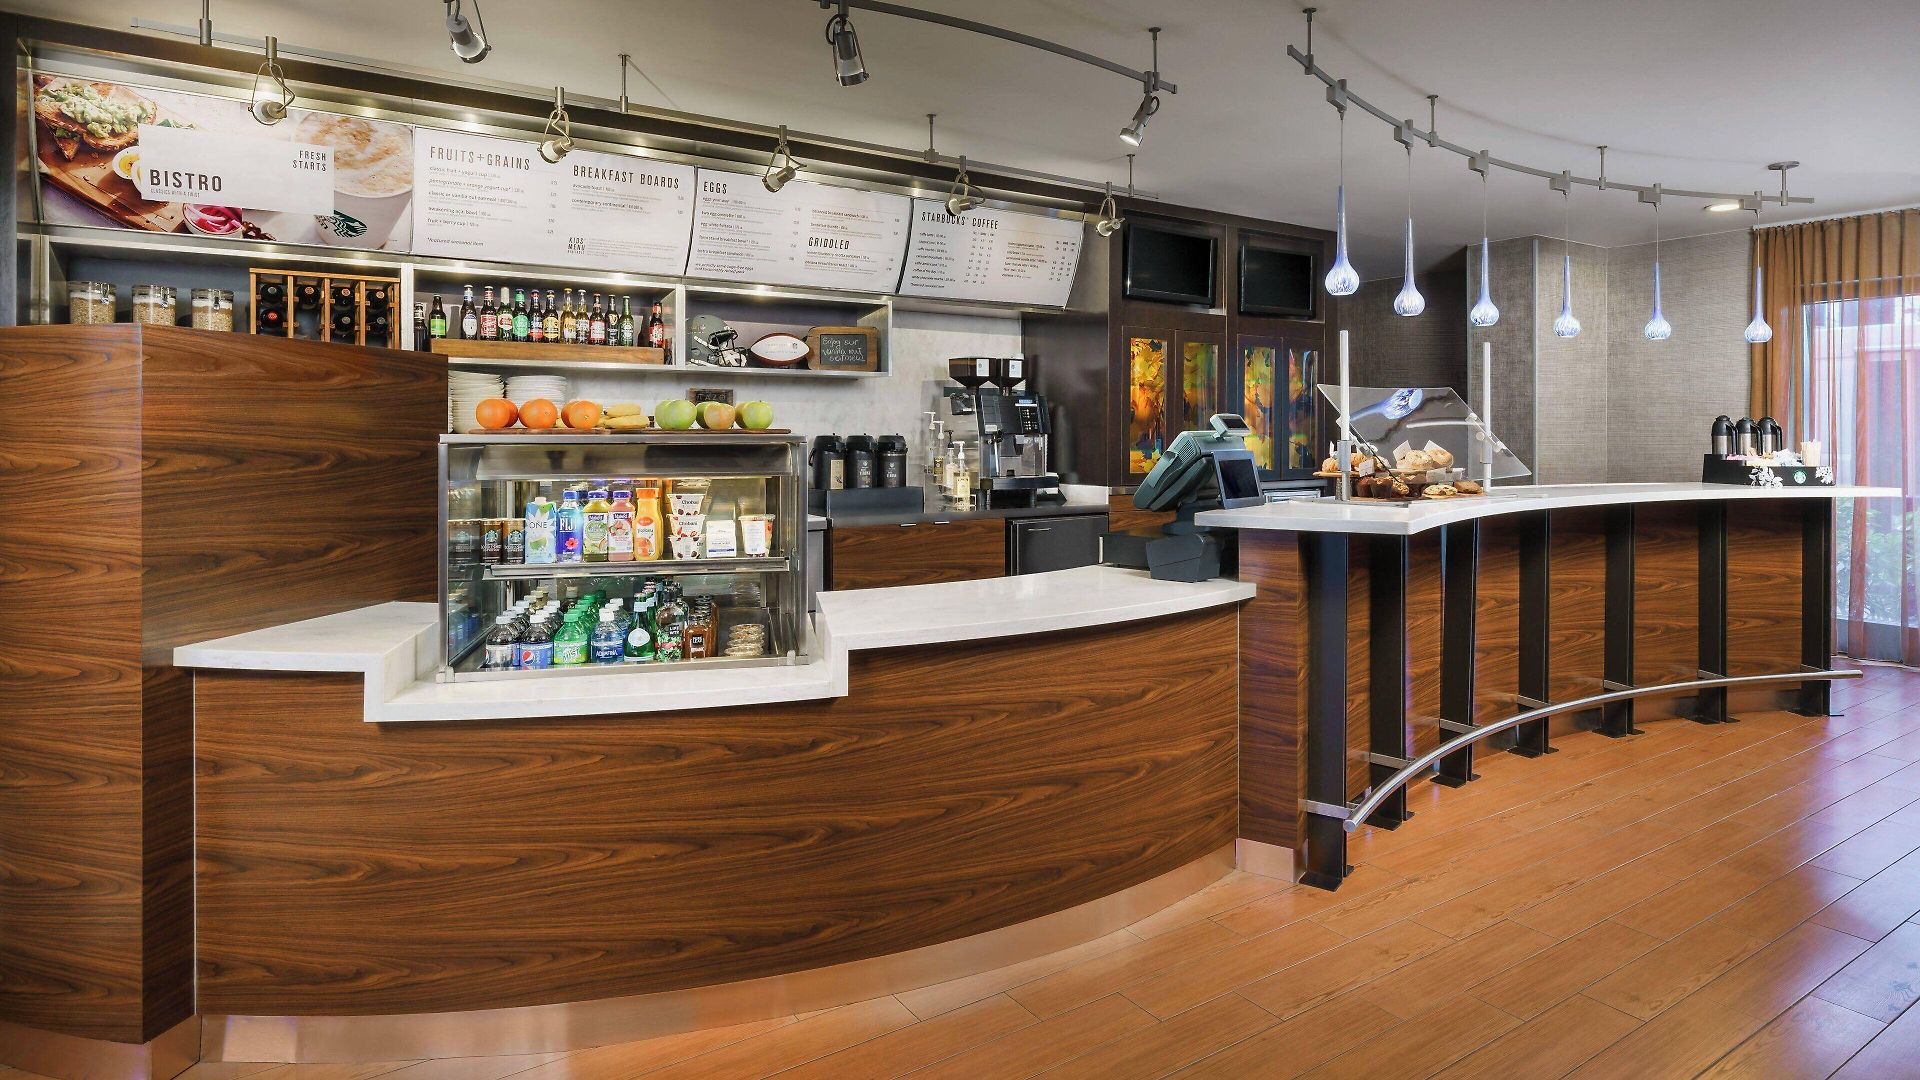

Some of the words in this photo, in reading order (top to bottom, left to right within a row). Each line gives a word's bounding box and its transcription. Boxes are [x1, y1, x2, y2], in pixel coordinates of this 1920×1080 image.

[299, 150, 326, 161] FRESH
[293, 160, 327, 171] STARTS
[150, 169, 222, 192] BISTRO
[573, 165, 634, 184] BREAKFAST
[640, 174, 680, 189] BOARDS
[704, 182, 727, 194] EGGS
[972, 218, 999, 230] COFFEE
[809, 237, 850, 250] GRIDDLED
[560, 518, 577, 531] FIJI
